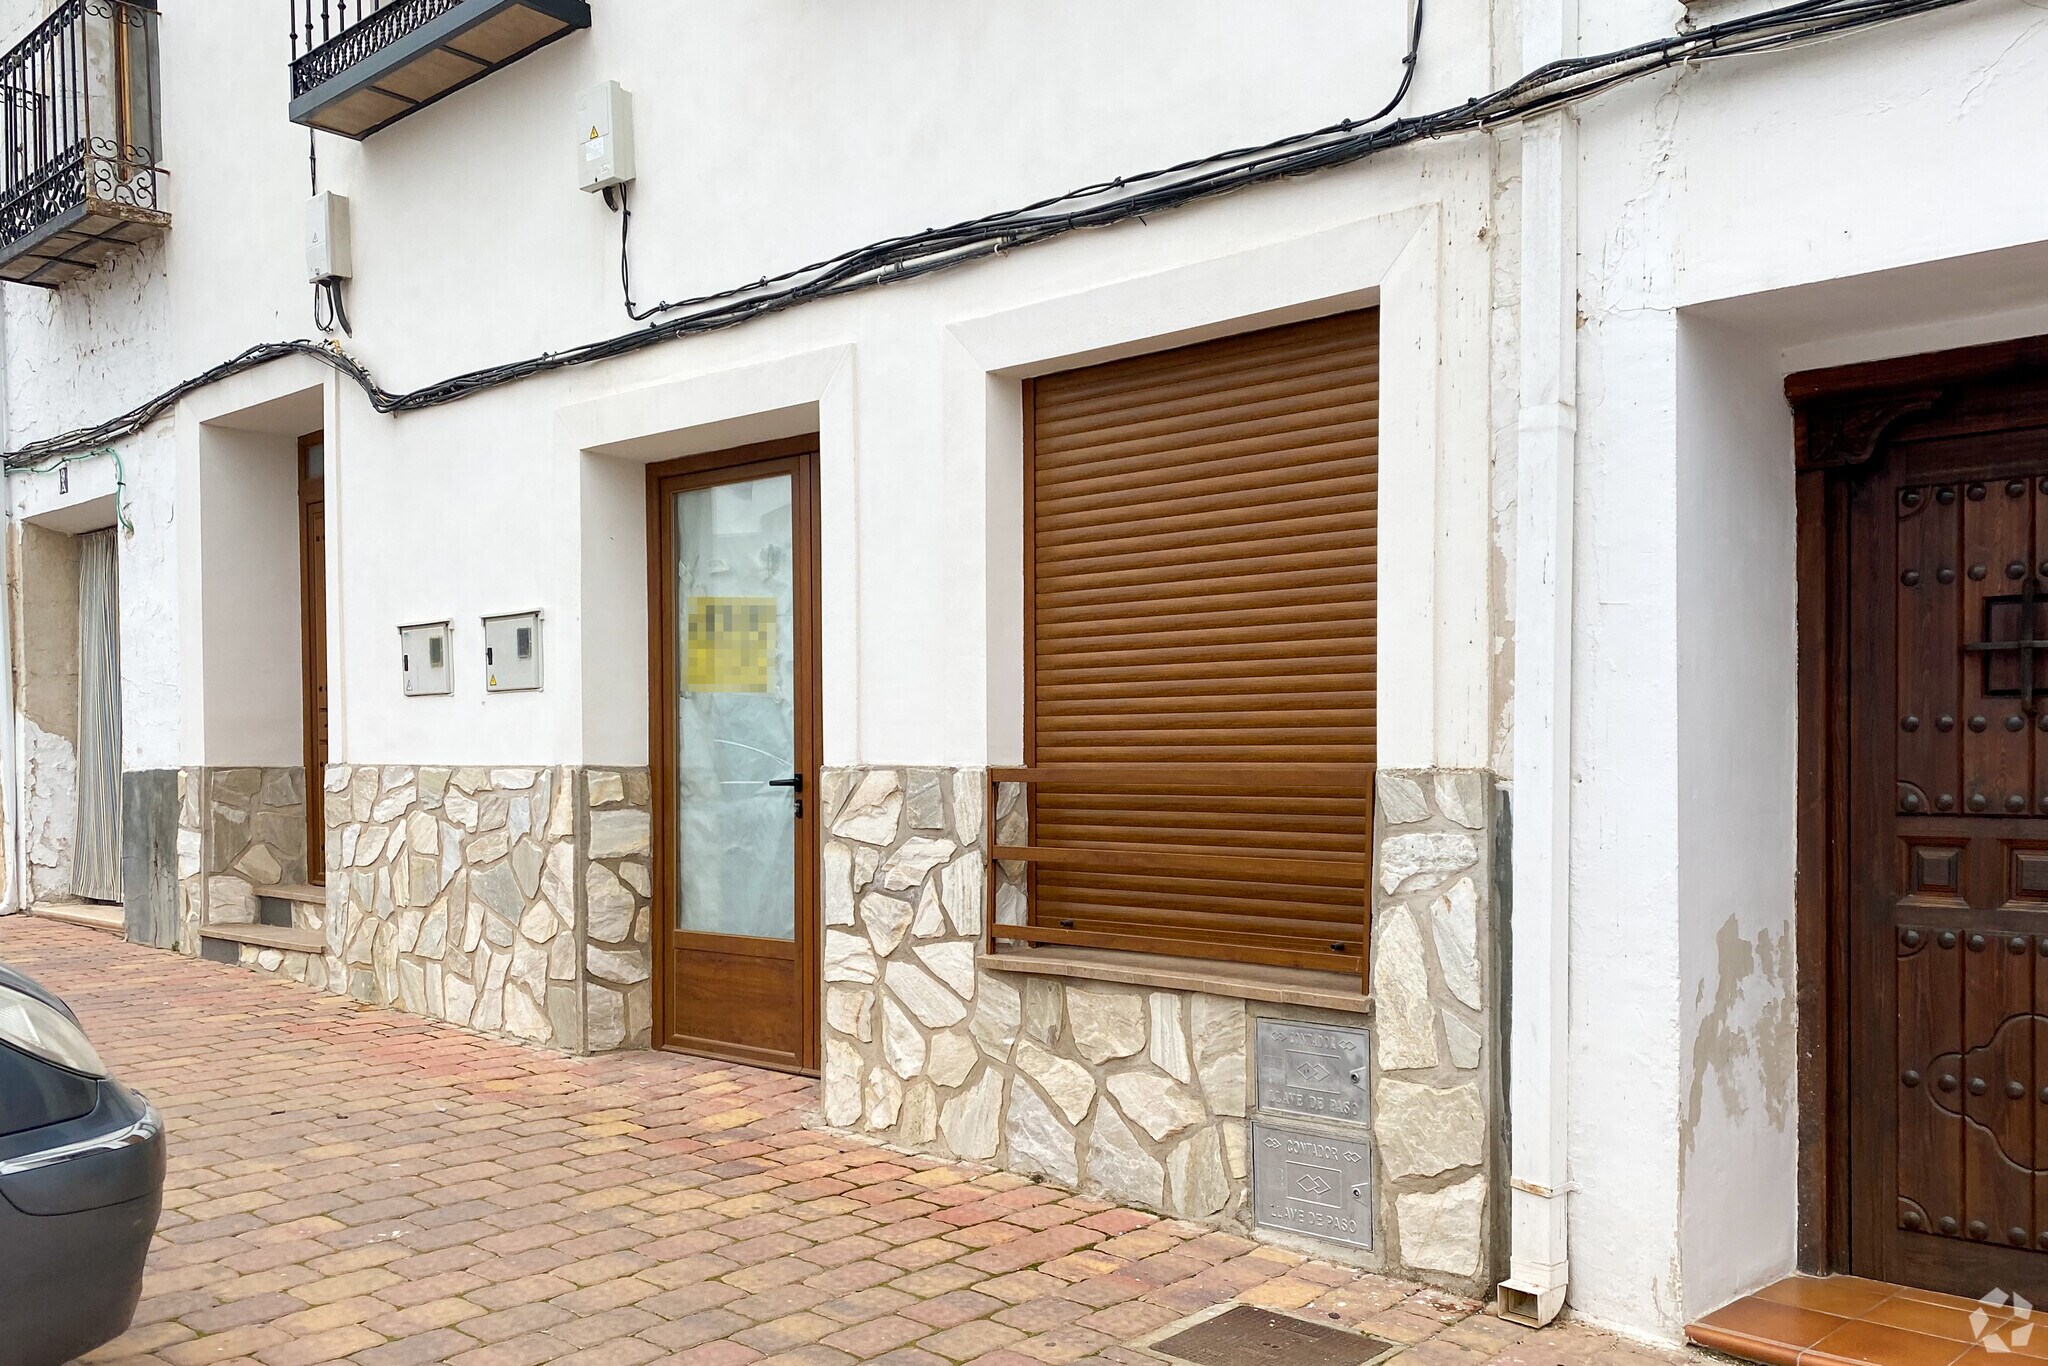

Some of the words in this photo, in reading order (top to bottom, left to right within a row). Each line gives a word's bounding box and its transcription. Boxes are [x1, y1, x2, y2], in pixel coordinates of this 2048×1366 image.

[1289, 1031, 1338, 1050] CONTADOR
[1309, 1095, 1324, 1110] DE
[1330, 1099, 1359, 1116] PASO
[1286, 1139, 1339, 1160] CONTADOR
[1270, 1203, 1305, 1223] LLAVE
[1308, 1211, 1323, 1226] DE
[1326, 1215, 1357, 1233] PASO
